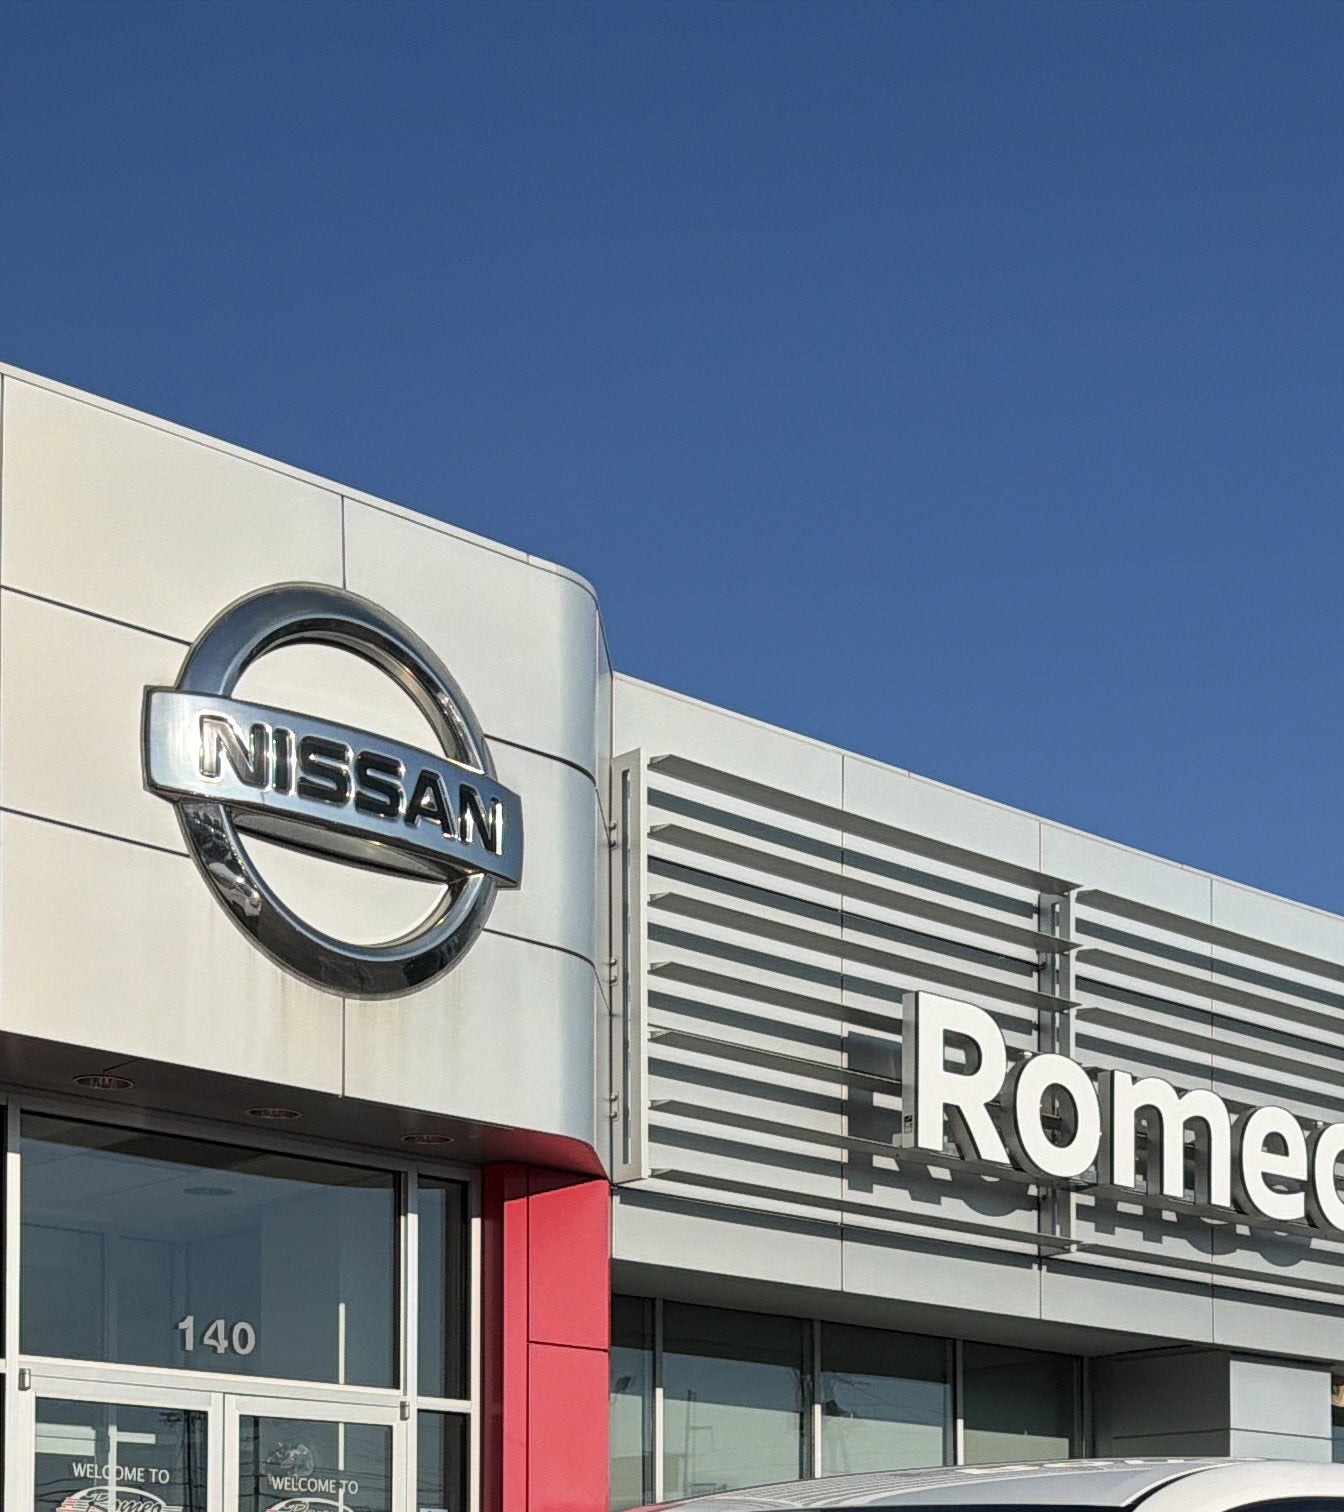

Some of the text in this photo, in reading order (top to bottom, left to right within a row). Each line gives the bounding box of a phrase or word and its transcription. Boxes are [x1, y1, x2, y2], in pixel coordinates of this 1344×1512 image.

[197, 709, 507, 857] NISSAN
[178, 1315, 256, 1355] 140
[72, 1462, 170, 1484] WELCOME TO
[272, 1476, 359, 1495] WELCOME TO
